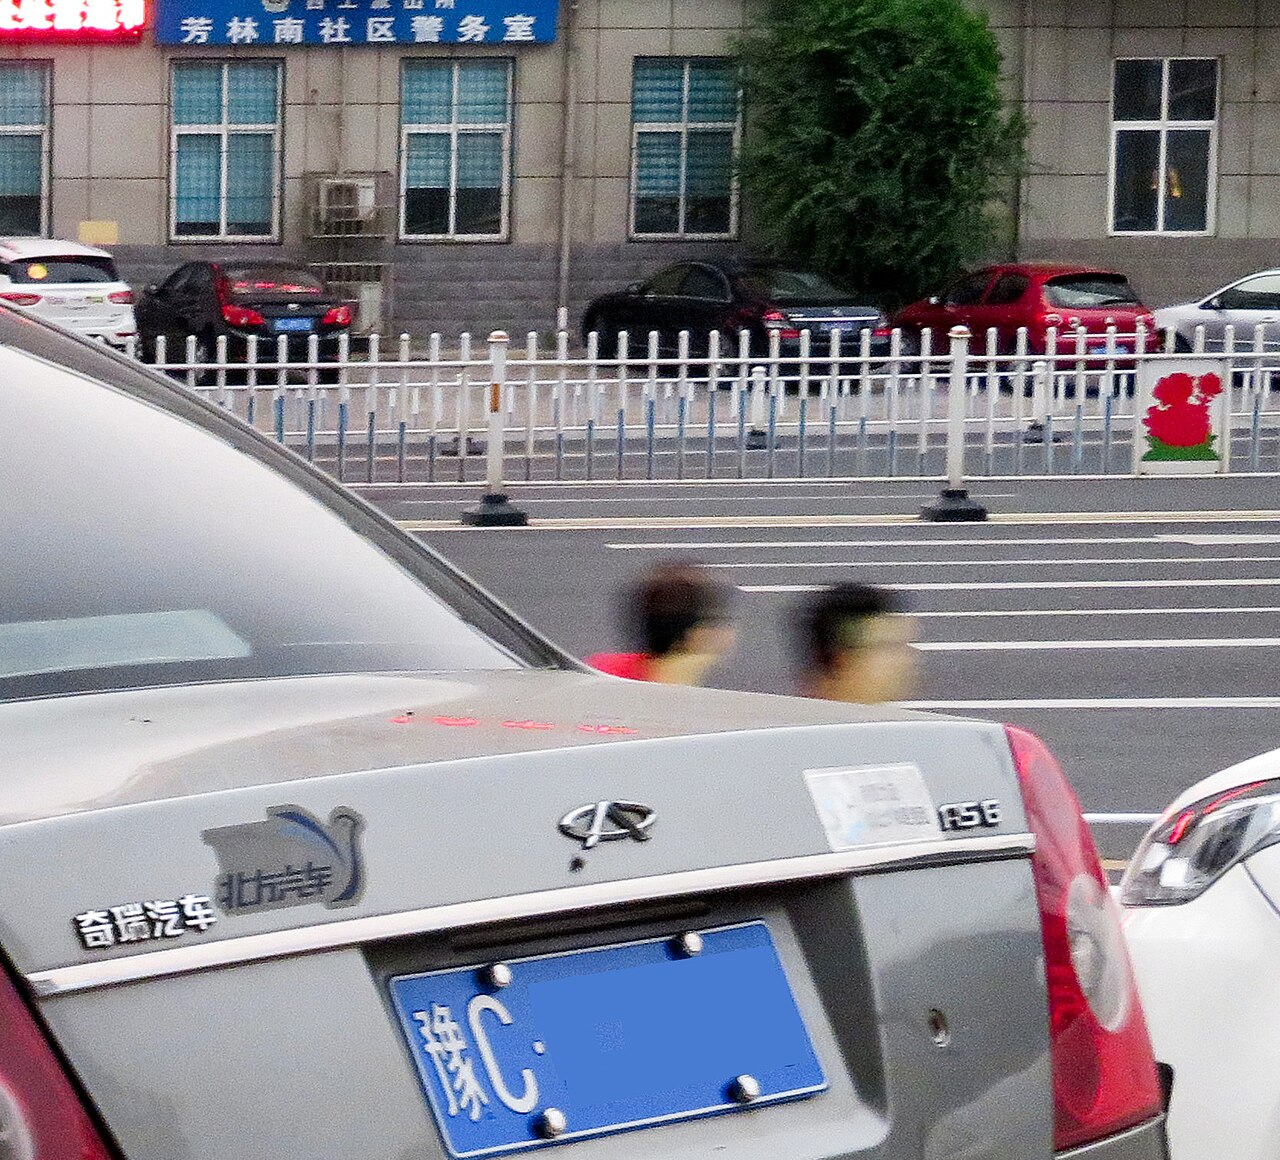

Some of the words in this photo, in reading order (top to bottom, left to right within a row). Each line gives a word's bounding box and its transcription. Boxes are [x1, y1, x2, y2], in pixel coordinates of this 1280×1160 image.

[180, 15, 538, 43] 芳林南社区警务室
[73, 894, 217, 949] 奇瑞汽车
